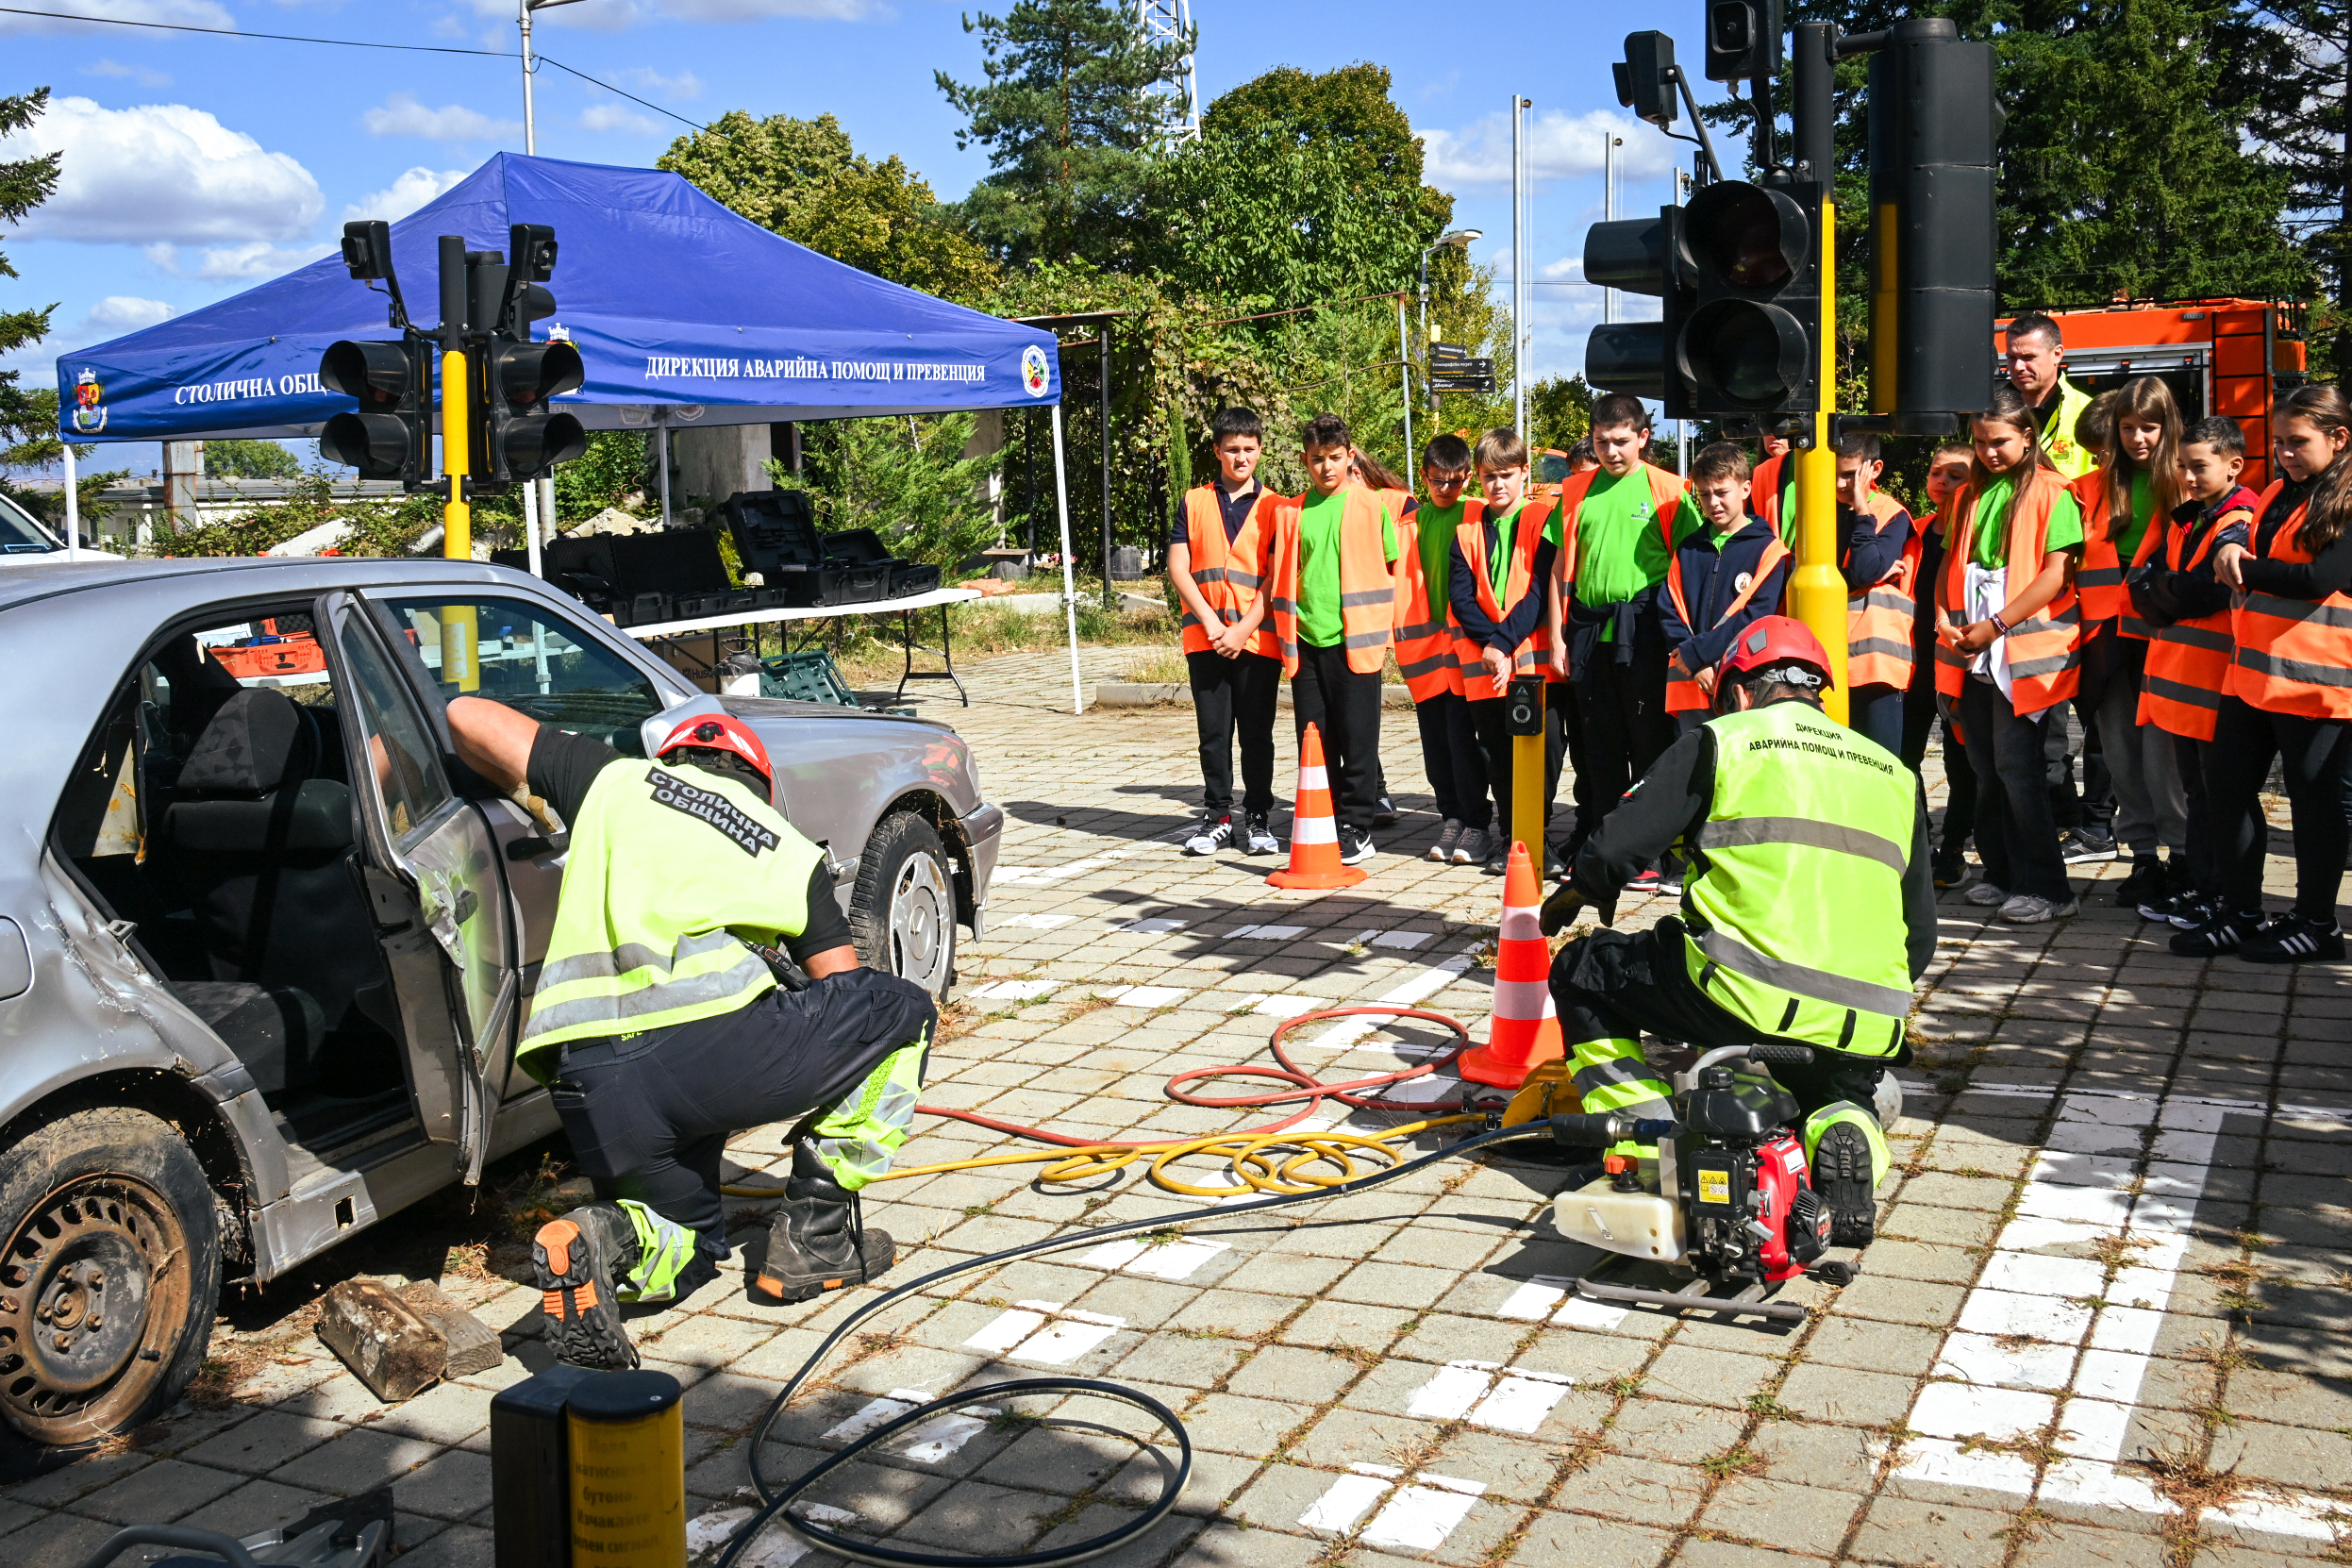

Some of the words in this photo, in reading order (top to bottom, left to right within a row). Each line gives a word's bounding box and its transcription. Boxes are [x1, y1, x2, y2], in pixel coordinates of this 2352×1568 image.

[645, 357, 740, 381] ДИРЕКЦИЯ
[743, 355, 828, 379] АВАРИЙНА
[831, 361, 891, 384] ПОМОЩ
[893, 363, 904, 380] И
[907, 363, 986, 385] ПРЕВЕНЦИЯ
[174, 376, 277, 406] СТОЛИЧНА
[1795, 723, 1843, 742] ДИРЕКЦИЯ
[1749, 737, 1801, 752] АВАРИЙНА
[1801, 742, 1838, 759] ПОМОЩ
[1838, 749, 1845, 759] И
[1845, 750, 1894, 776] ПРЕВЕНЦИЯ
[651, 772, 774, 846] СТОЛИЧНА
[656, 789, 757, 852] ОБЩИНА
